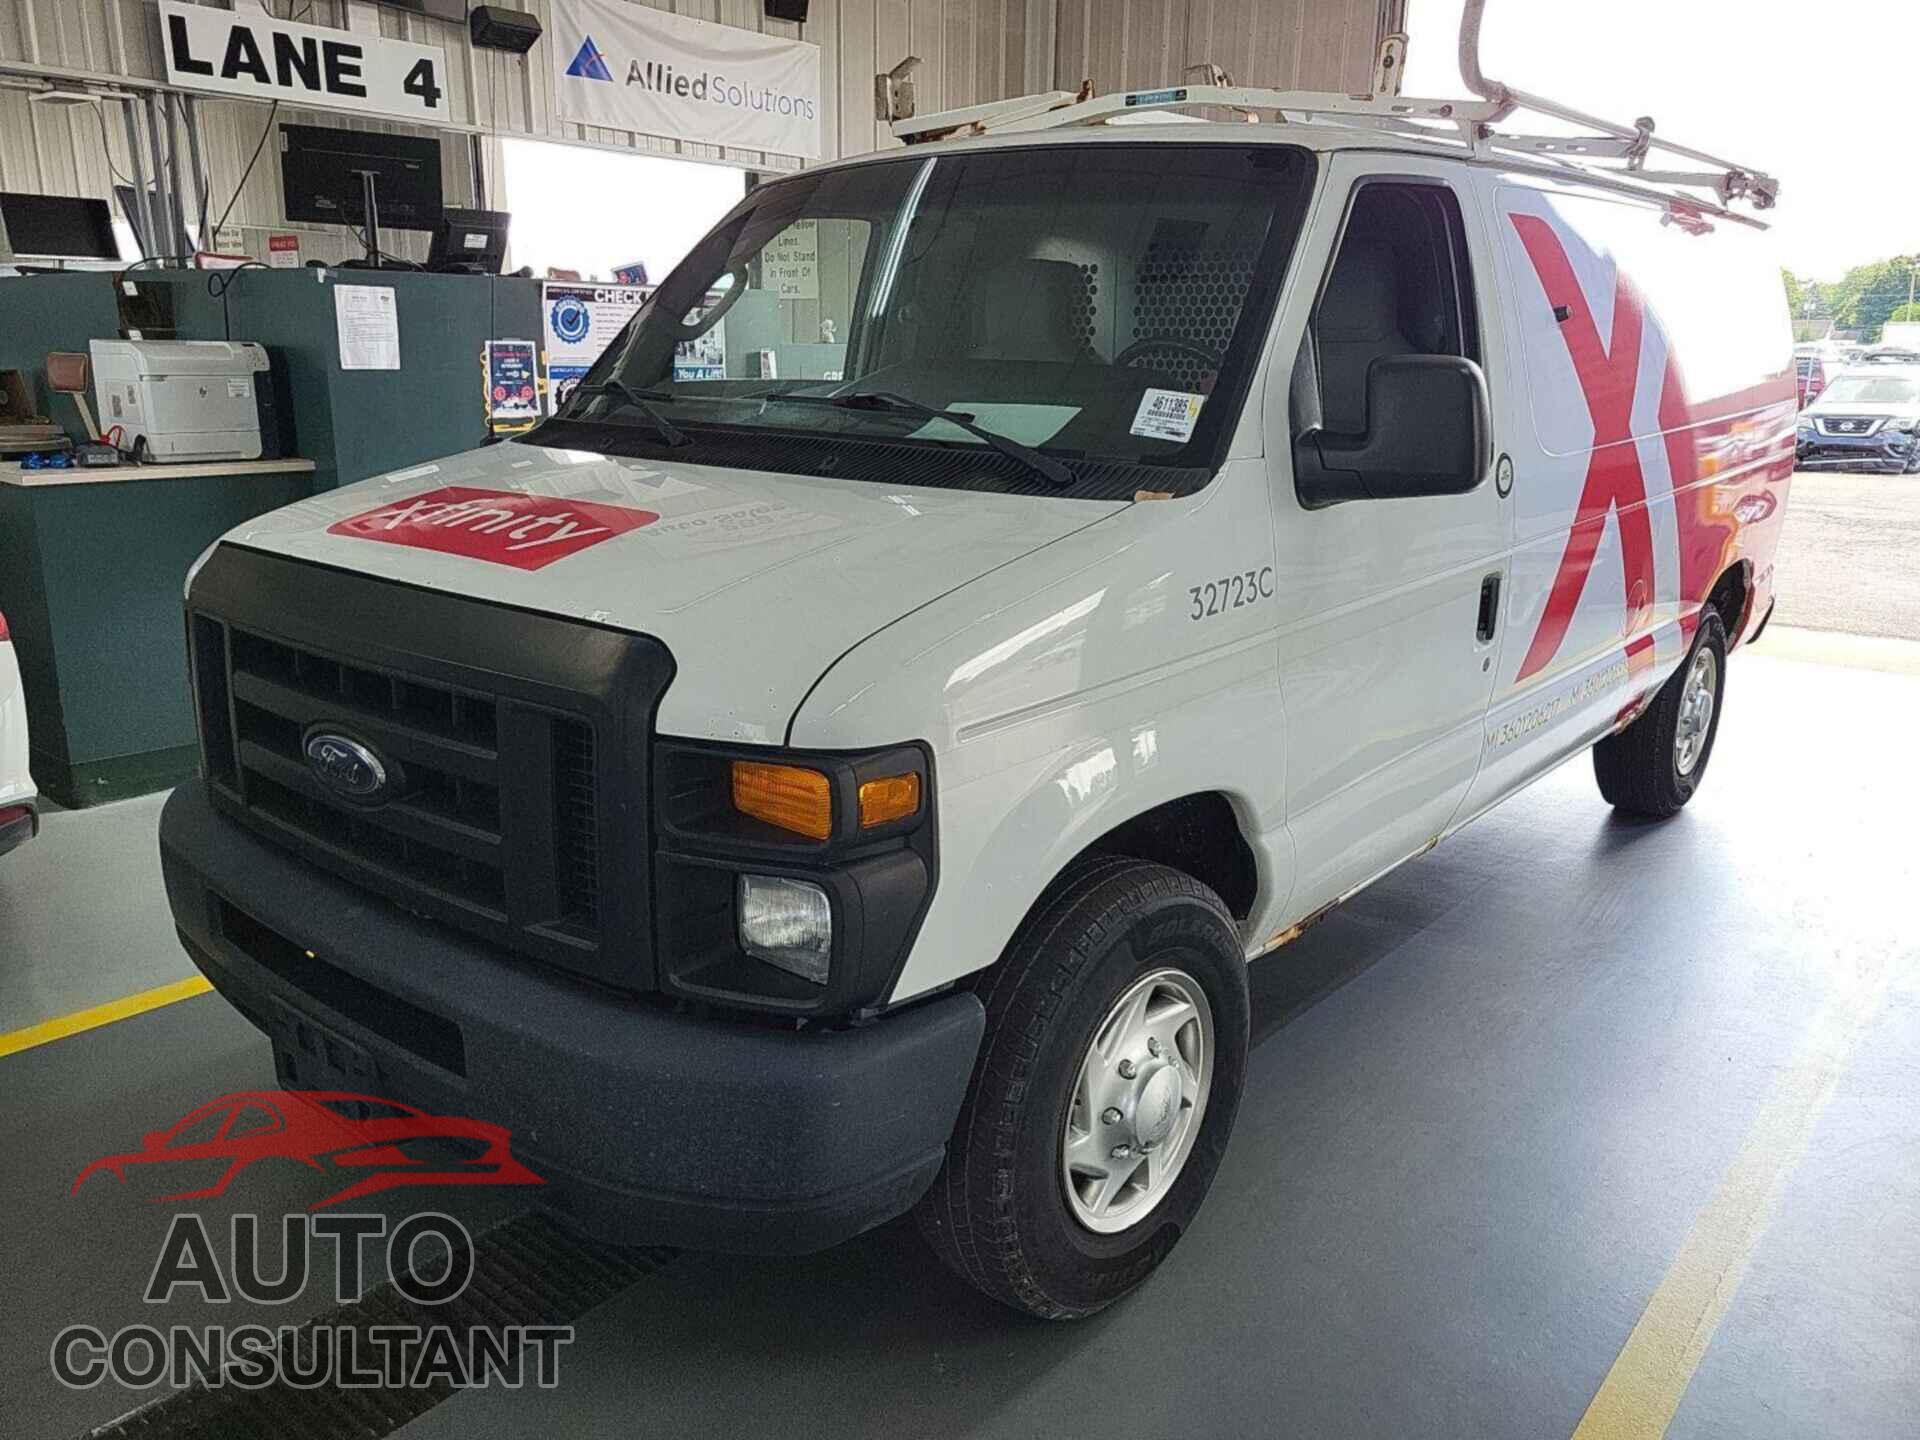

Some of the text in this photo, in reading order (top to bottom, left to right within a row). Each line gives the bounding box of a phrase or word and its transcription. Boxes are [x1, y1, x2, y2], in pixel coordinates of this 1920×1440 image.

[168, 14, 441, 108] LANE 4
[594, 289, 642, 304] CHECK
[1189, 566, 1274, 621] 32723C
